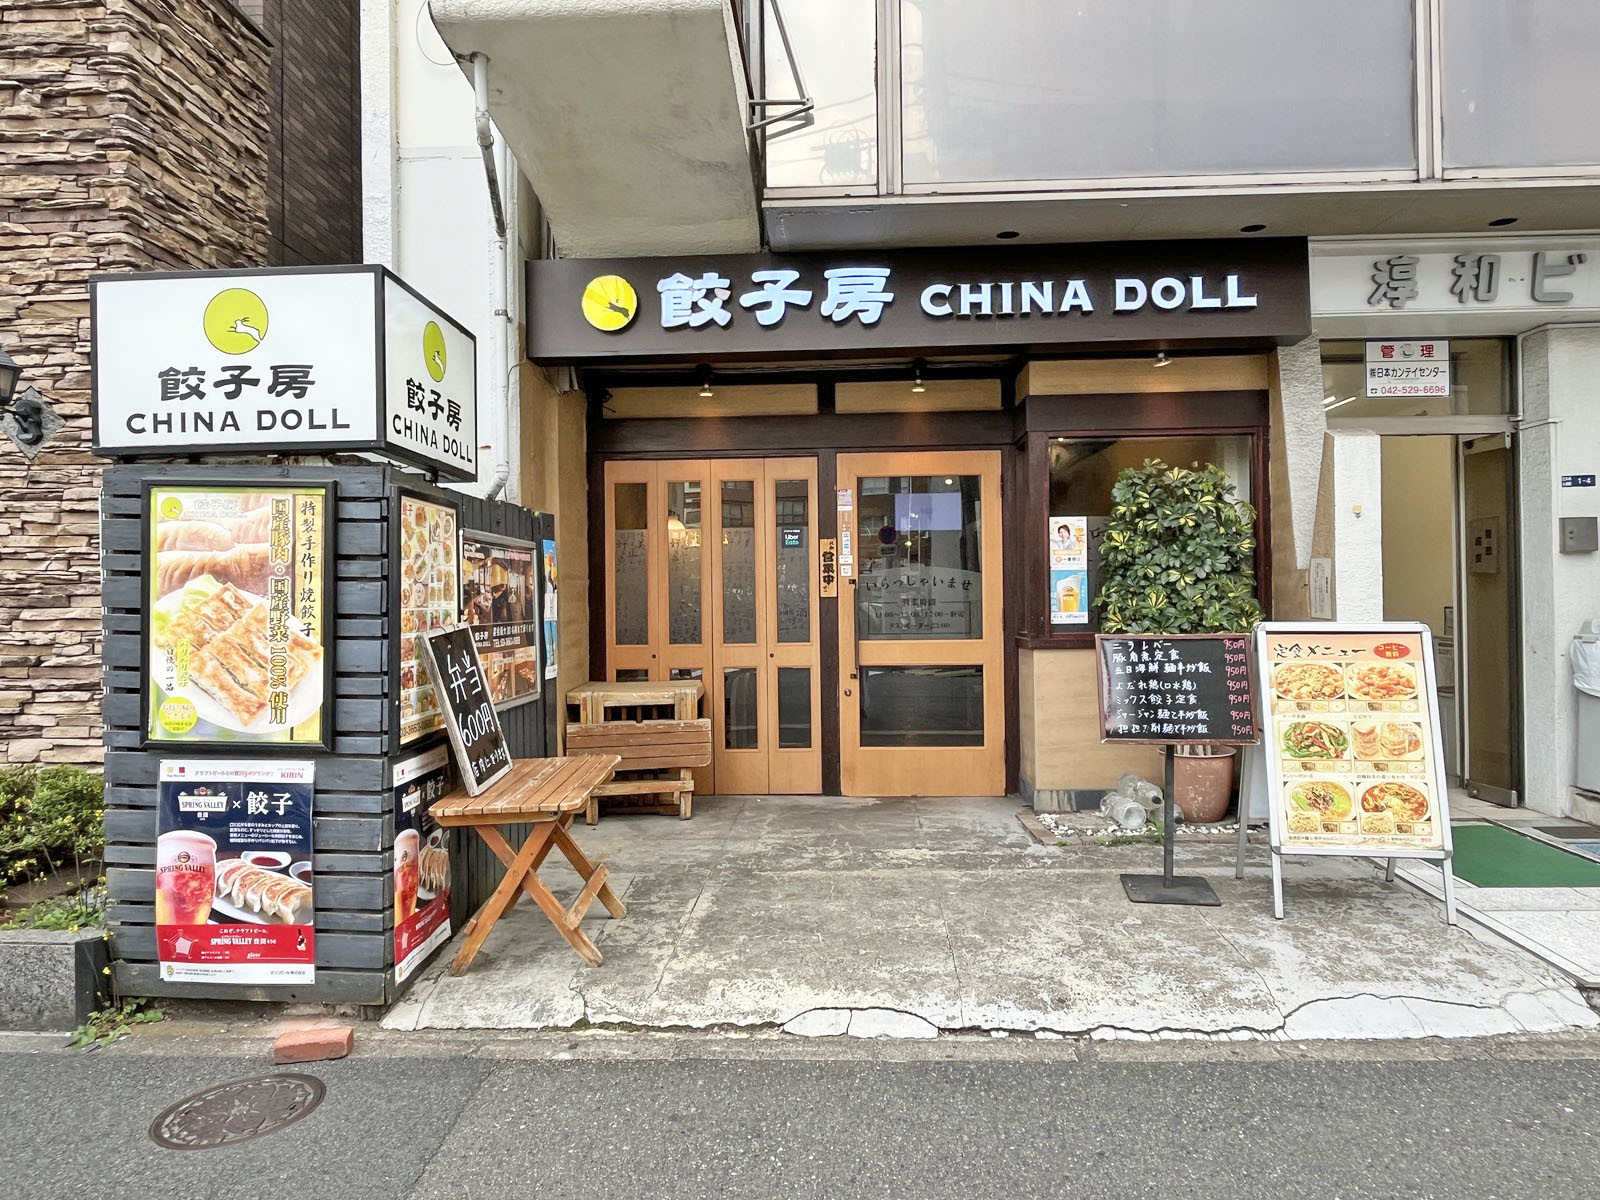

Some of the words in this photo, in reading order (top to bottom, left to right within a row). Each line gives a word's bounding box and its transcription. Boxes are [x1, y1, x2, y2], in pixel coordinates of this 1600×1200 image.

[657, 267, 894, 328] 餃子房
[920, 279, 1095, 317] CHINA
[1113, 274, 1258, 311] DOLL
[157, 364, 316, 402] 餃子房
[1380, 385, 1447, 395] 042-529-6696
[406, 377, 463, 432] 餃子房
[126, 409, 241, 434] CHINA
[256, 407, 351, 431] DOLL
[391, 414, 438, 450] CHINA
[442, 434, 473, 464] DOLL
[1577, 477, 1592, 485] 1-4
[300, 501, 317, 637] 特製手作り焼餃子
[866, 576, 972, 591] いらっしゃいませ
[1223, 639, 1245, 651] 950円
[1273, 643, 1368, 659] 定食メニュー
[1224, 653, 1246, 663] 950円
[1225, 666, 1247, 677] 950円
[1226, 681, 1248, 691] 950円
[1228, 694, 1250, 704] 950円
[1230, 711, 1251, 720] 950円
[458, 702, 496, 747] 600円
[1231, 724, 1253, 735] 950円
[280, 771, 304, 779] KIRIN
[181, 801, 203, 809] SPRING
[203, 801, 225, 809] VALLEY
[246, 790, 293, 816] 餃子
[160, 864, 183, 874] SPRING
